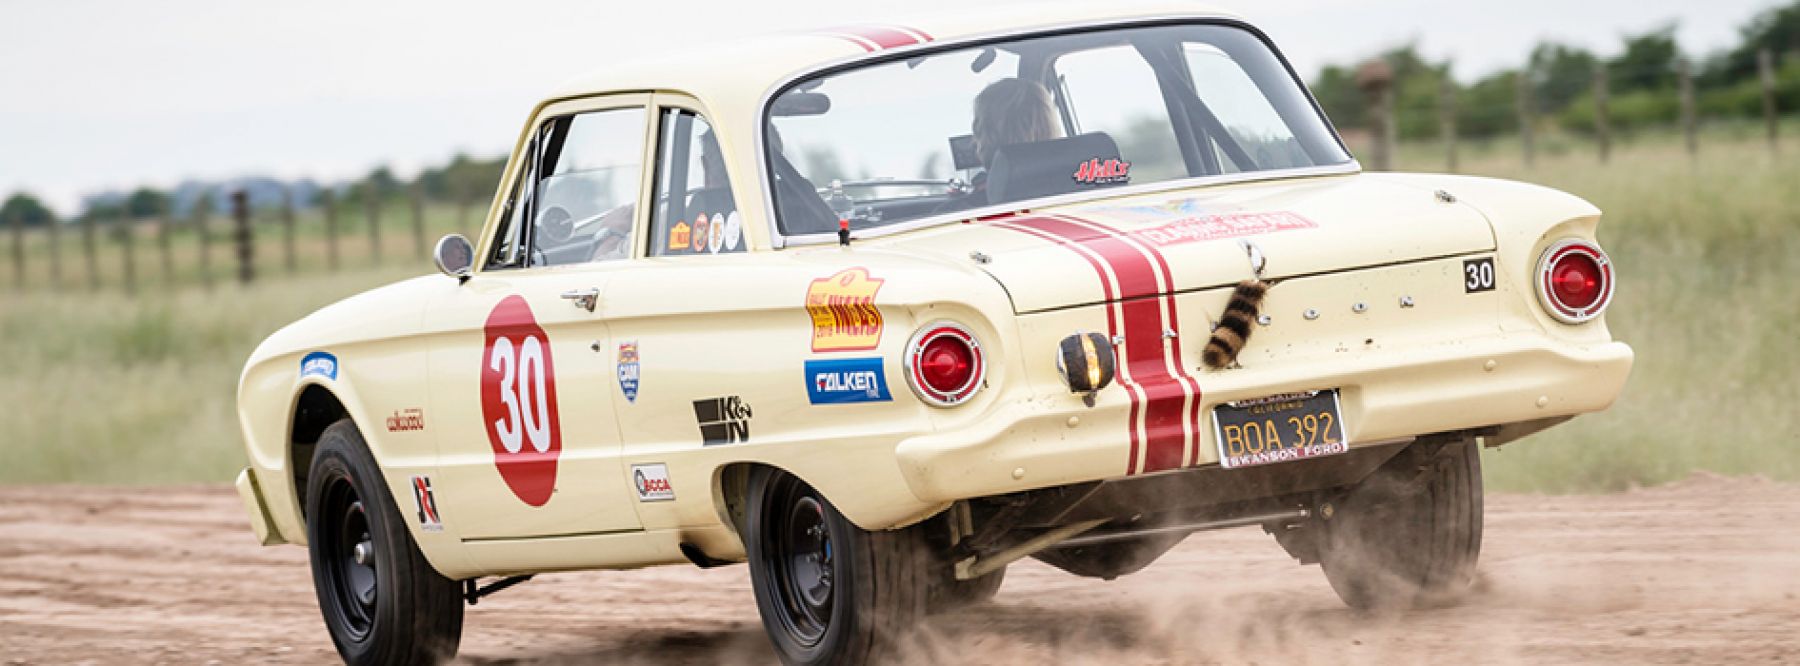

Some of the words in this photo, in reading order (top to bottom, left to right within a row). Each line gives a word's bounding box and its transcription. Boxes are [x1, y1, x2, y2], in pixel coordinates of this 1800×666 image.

[1465, 261, 1493, 290] 30
[490, 335, 551, 455] 30
[816, 371, 877, 392] FALKEN
[1223, 418, 1283, 458] BOA
[1287, 410, 1338, 449] 392
